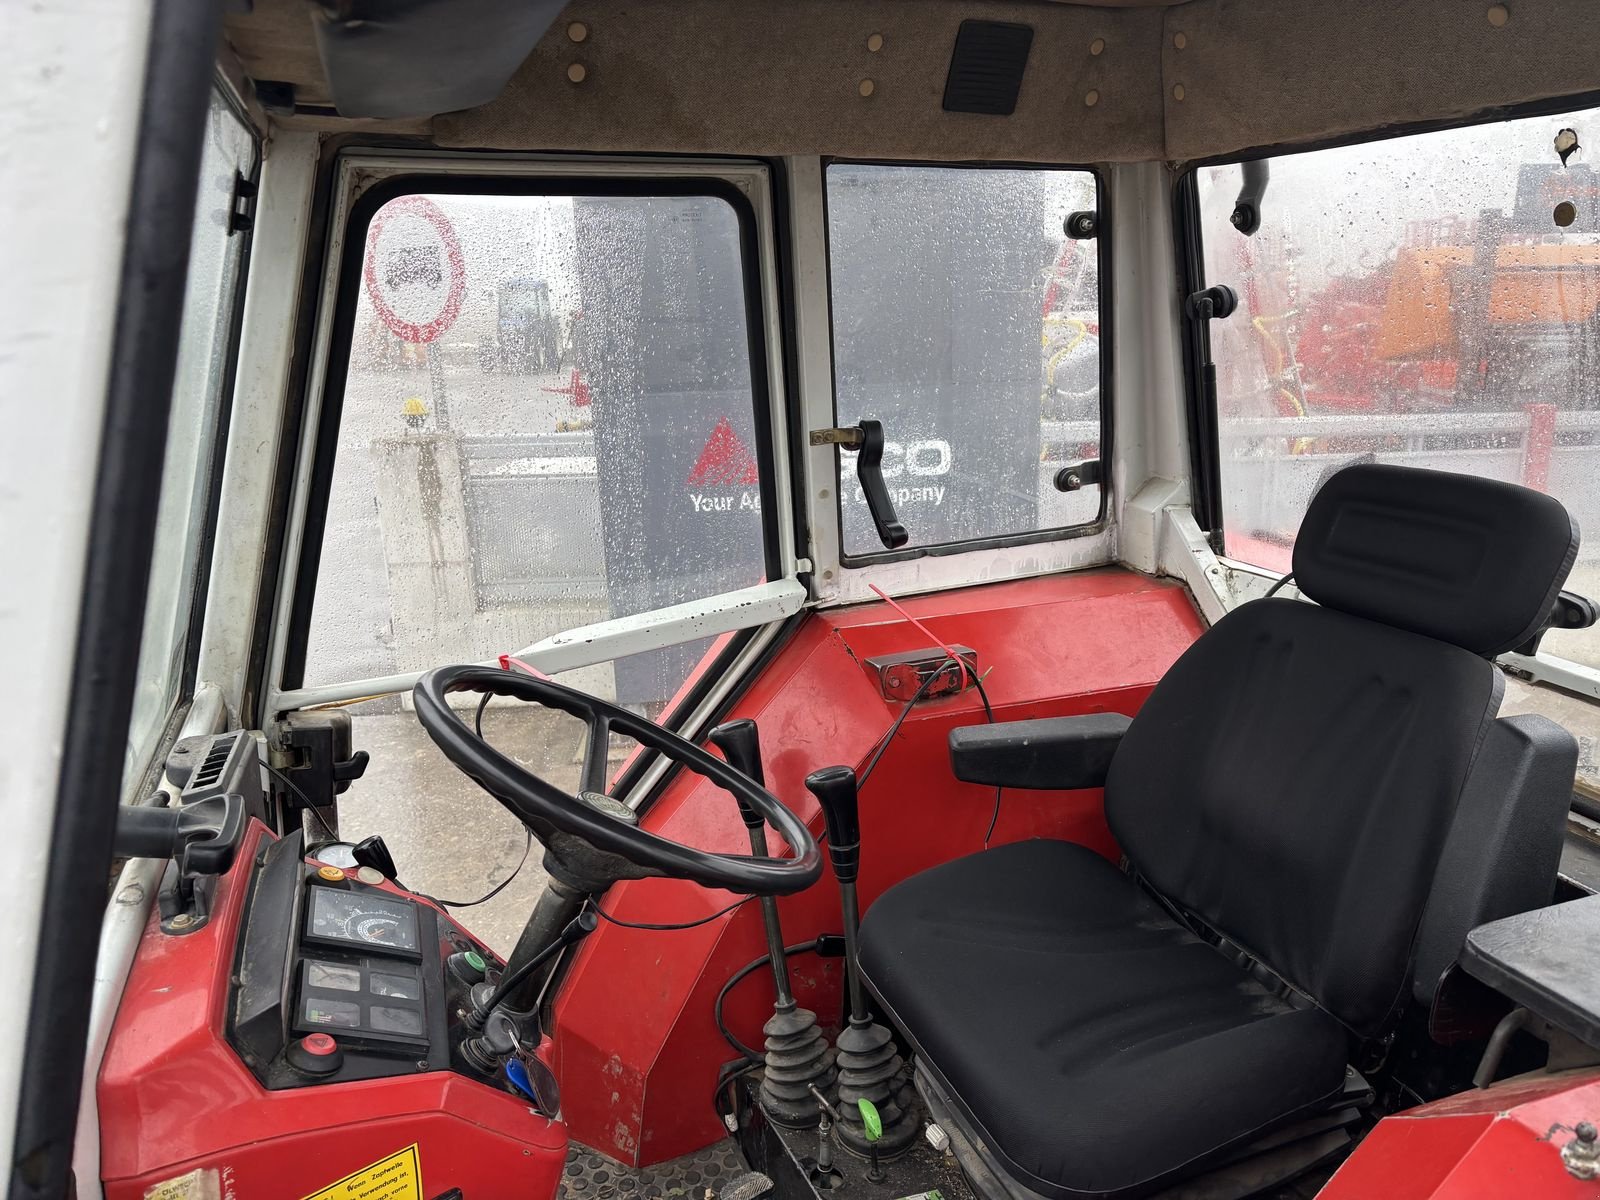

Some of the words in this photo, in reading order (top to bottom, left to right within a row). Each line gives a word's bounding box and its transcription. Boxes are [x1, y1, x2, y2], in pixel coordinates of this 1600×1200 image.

[689, 493, 734, 512] Your
[346, 1180, 366, 1192] Wenn
[371, 1161, 403, 1180] Zapfwelle
[358, 1175, 398, 1199] Verwendung
[391, 1183, 408, 1195] vorne
